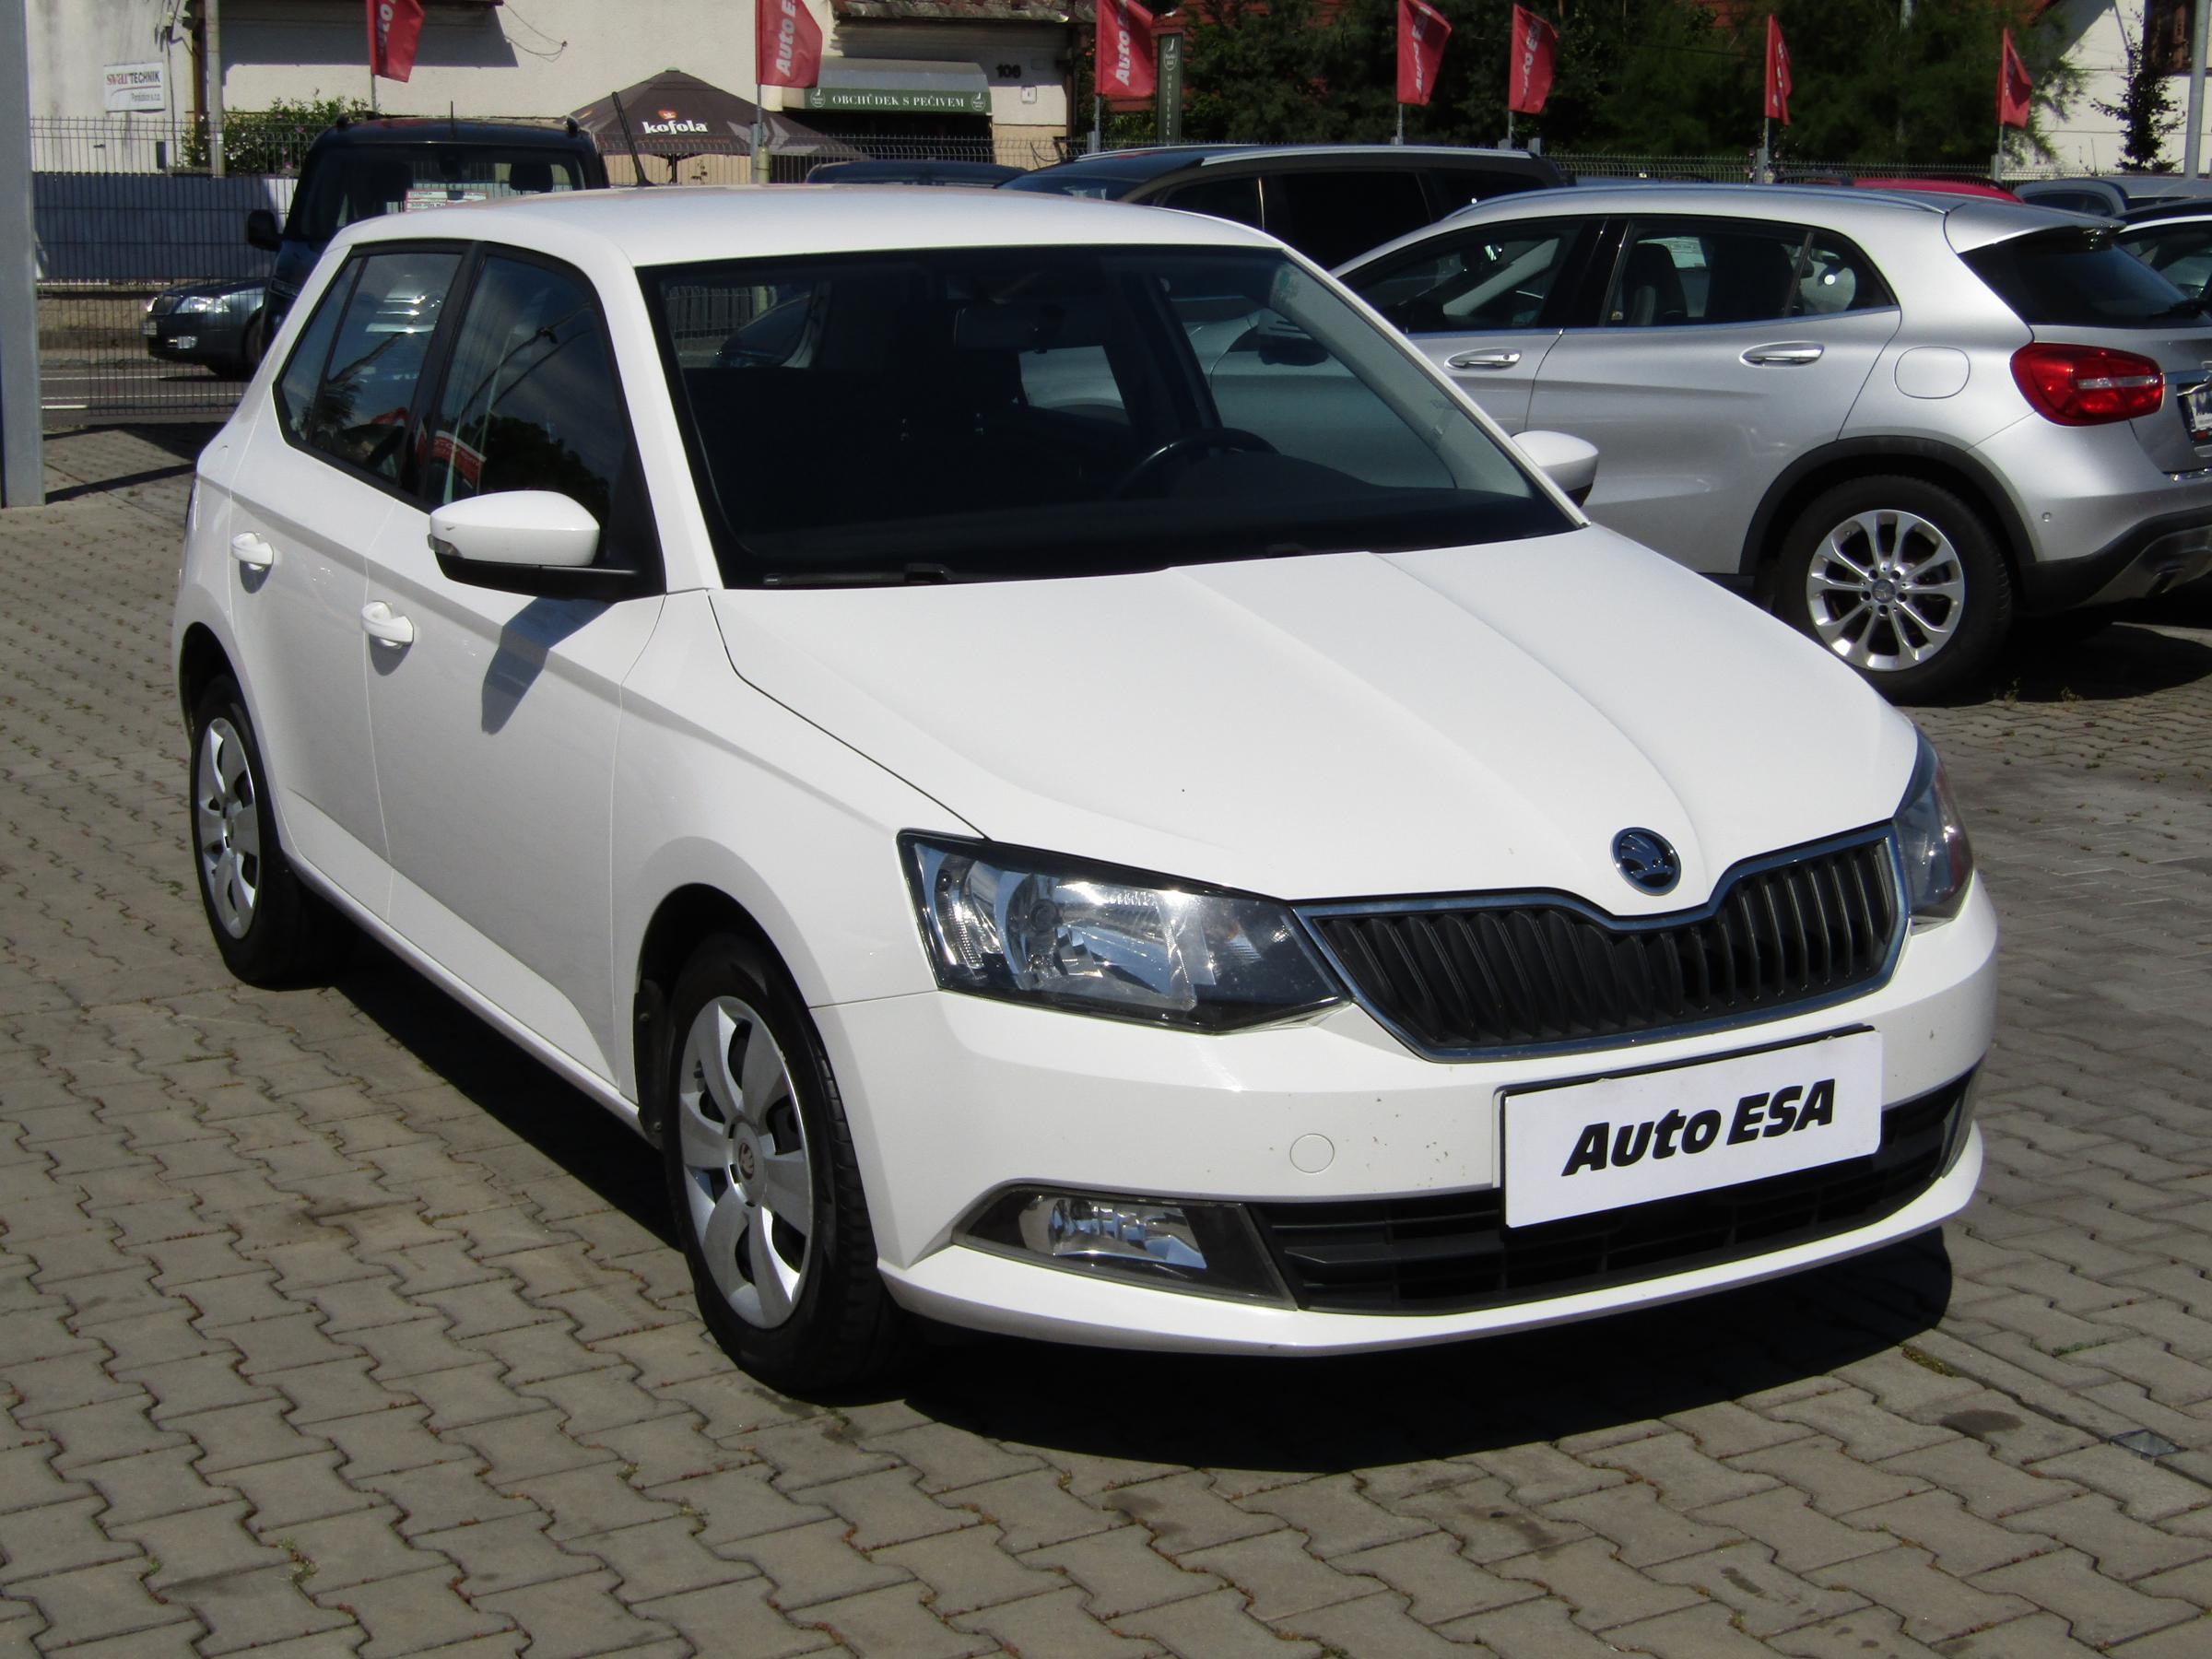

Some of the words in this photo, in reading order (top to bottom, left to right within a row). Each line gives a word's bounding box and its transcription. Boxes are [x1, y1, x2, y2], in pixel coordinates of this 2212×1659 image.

[776, 18, 796, 77] Auto
[1115, 30, 1131, 87] Auto
[641, 120, 708, 135] kofola
[832, 93, 900, 106] OBCHŮDEK
[903, 97, 909, 105] S
[913, 95, 965, 107] PEČIVEM
[1561, 1109, 1721, 1176] Auto
[1726, 1078, 1835, 1146] ESA
